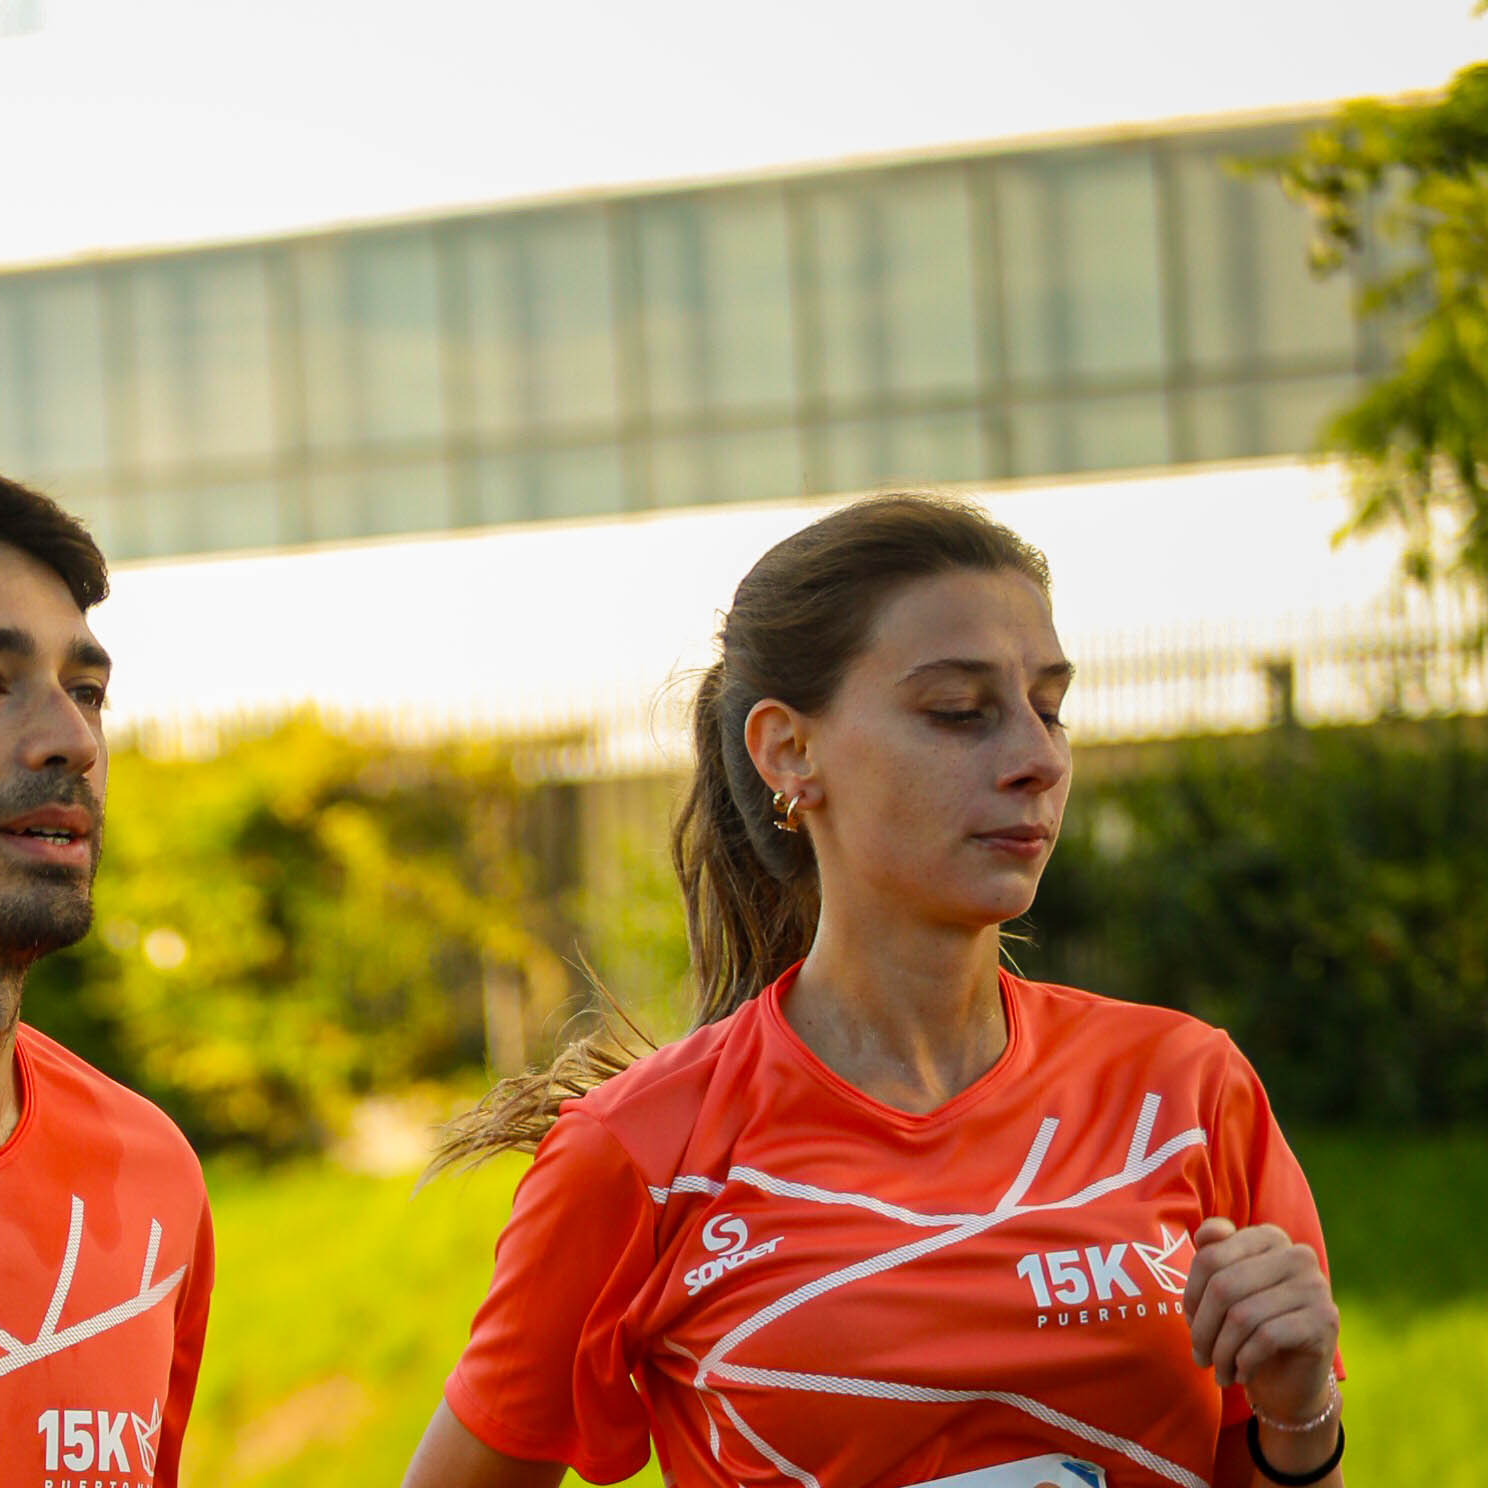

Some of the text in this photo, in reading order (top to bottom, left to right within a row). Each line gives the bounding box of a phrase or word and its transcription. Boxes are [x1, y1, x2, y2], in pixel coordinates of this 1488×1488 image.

[1016, 1243, 1142, 1308] 15K
[1037, 1303, 1147, 1328] PUERTO
[38, 1409, 131, 1473] 15K
